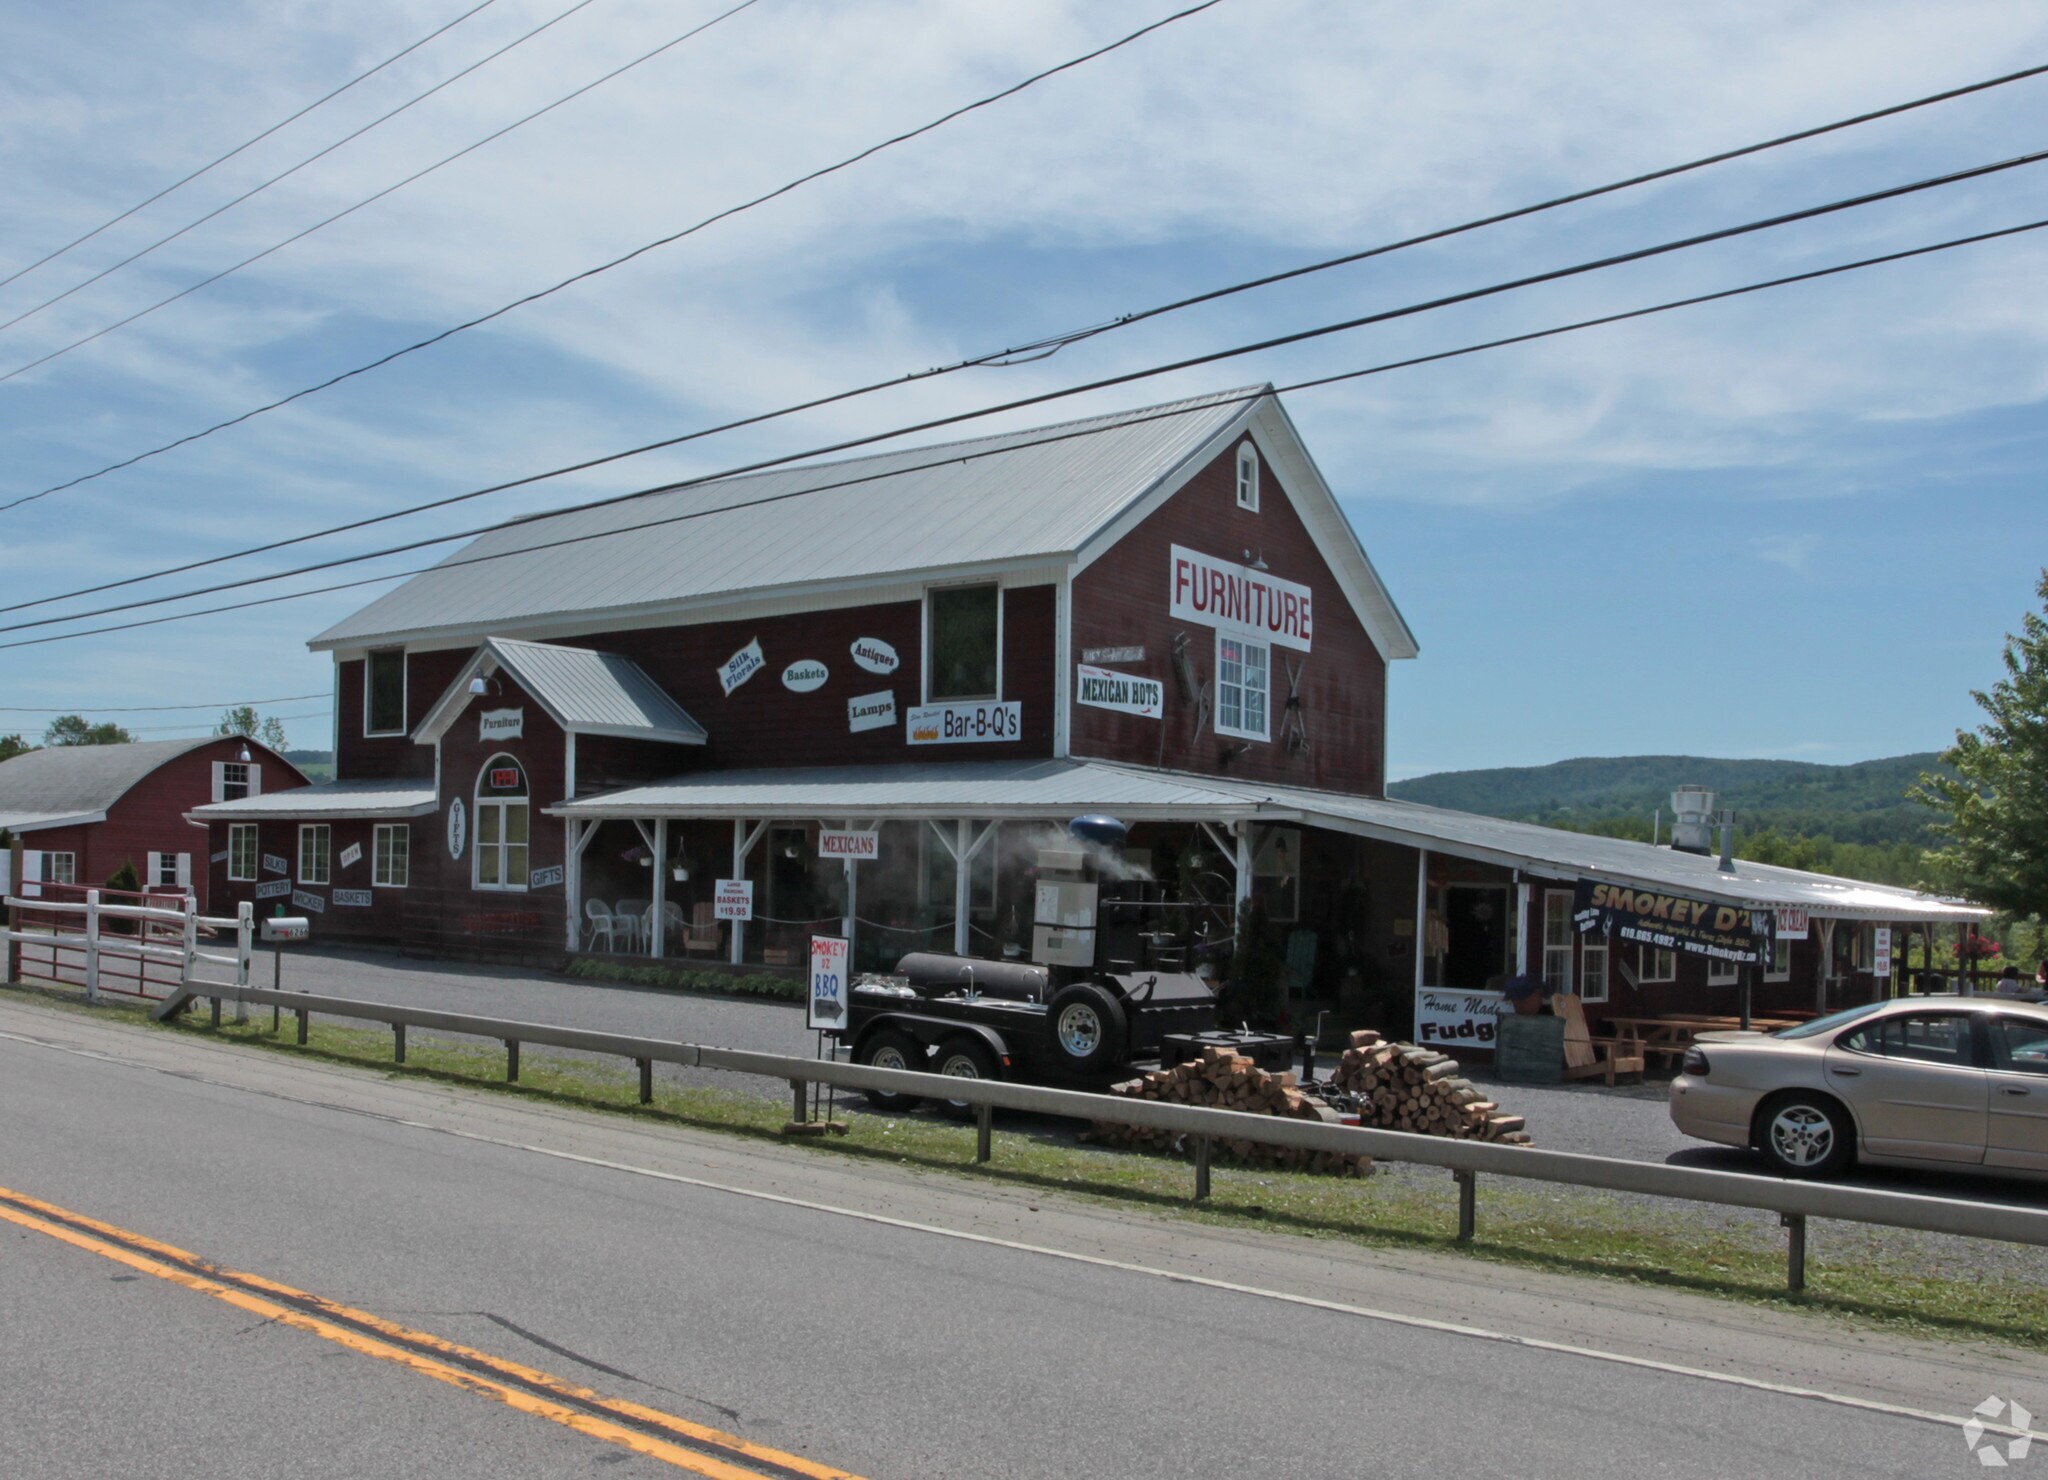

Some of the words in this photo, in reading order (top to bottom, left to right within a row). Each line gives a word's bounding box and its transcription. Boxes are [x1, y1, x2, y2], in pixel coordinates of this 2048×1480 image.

[1176, 558, 1310, 640] FURNITURE
[728, 651, 750, 673] Silk
[854, 643, 894, 666] Antiques
[726, 656, 761, 688] Florals
[787, 668, 825, 681] Baskets
[1082, 677, 1129, 703] MEXICAN
[1132, 682, 1159, 706] HOTS
[852, 702, 892, 719] Lamps
[484, 717, 520, 729] Furniture
[944, 706, 1017, 738] Bar-B-Q's
[822, 836, 874, 854] MEXICANS
[265, 856, 286, 873] SILKS
[532, 867, 562, 885] GIFTS
[257, 881, 290, 896] POTTERY
[334, 891, 371, 904] BASKETS
[294, 892, 323, 910] WICKER
[717, 896, 750, 904] BASKETS
[1591, 884, 1710, 925] SMOKEY
[811, 940, 846, 957] SMOKEY
[815, 973, 839, 998] BBQ
[1423, 994, 1457, 1013] Home
[1420, 1019, 1498, 1042] Fudg
